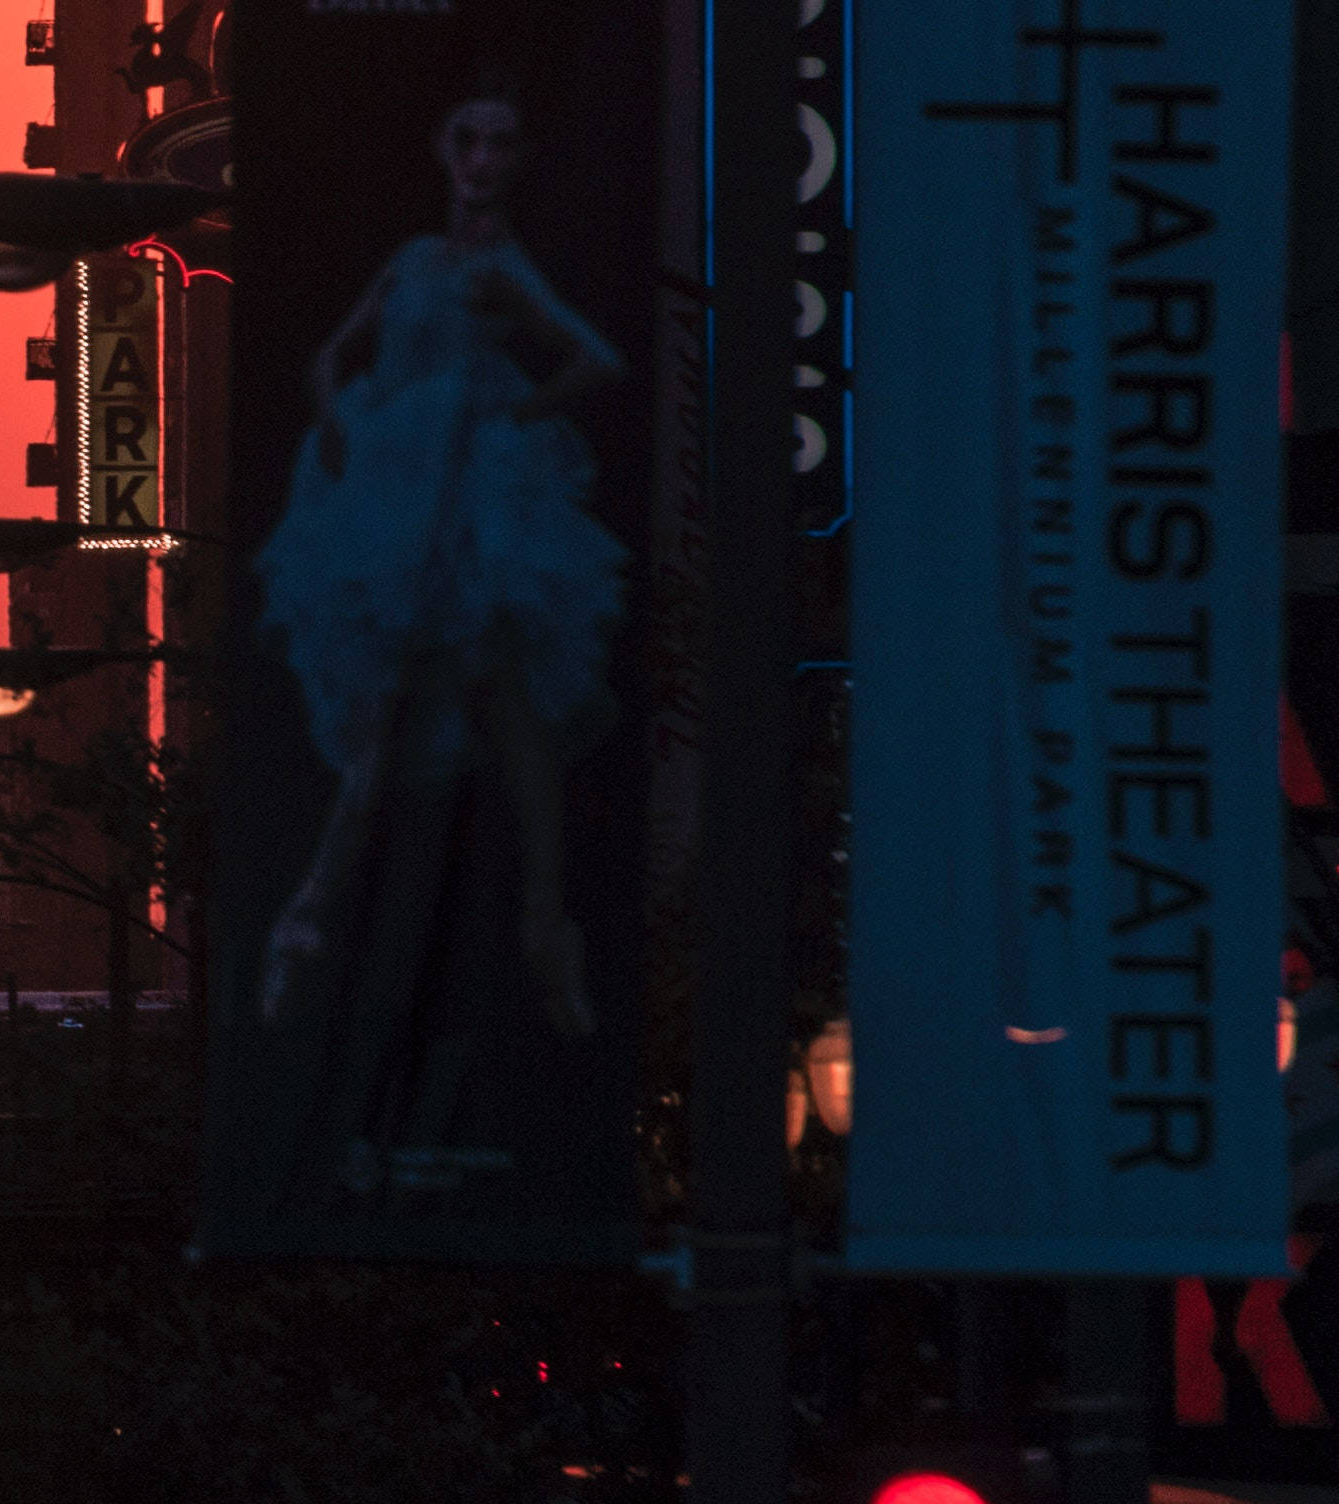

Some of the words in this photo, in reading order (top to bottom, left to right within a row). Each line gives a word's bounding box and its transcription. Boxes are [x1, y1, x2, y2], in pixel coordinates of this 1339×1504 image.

[97, 268, 148, 527] PARK
[1029, 205, 1075, 684] MILLENNIUM
[1108, 84, 1216, 580] HARRIS
[1030, 730, 1075, 919] PARK
[1108, 612, 1214, 1174] THEATER
